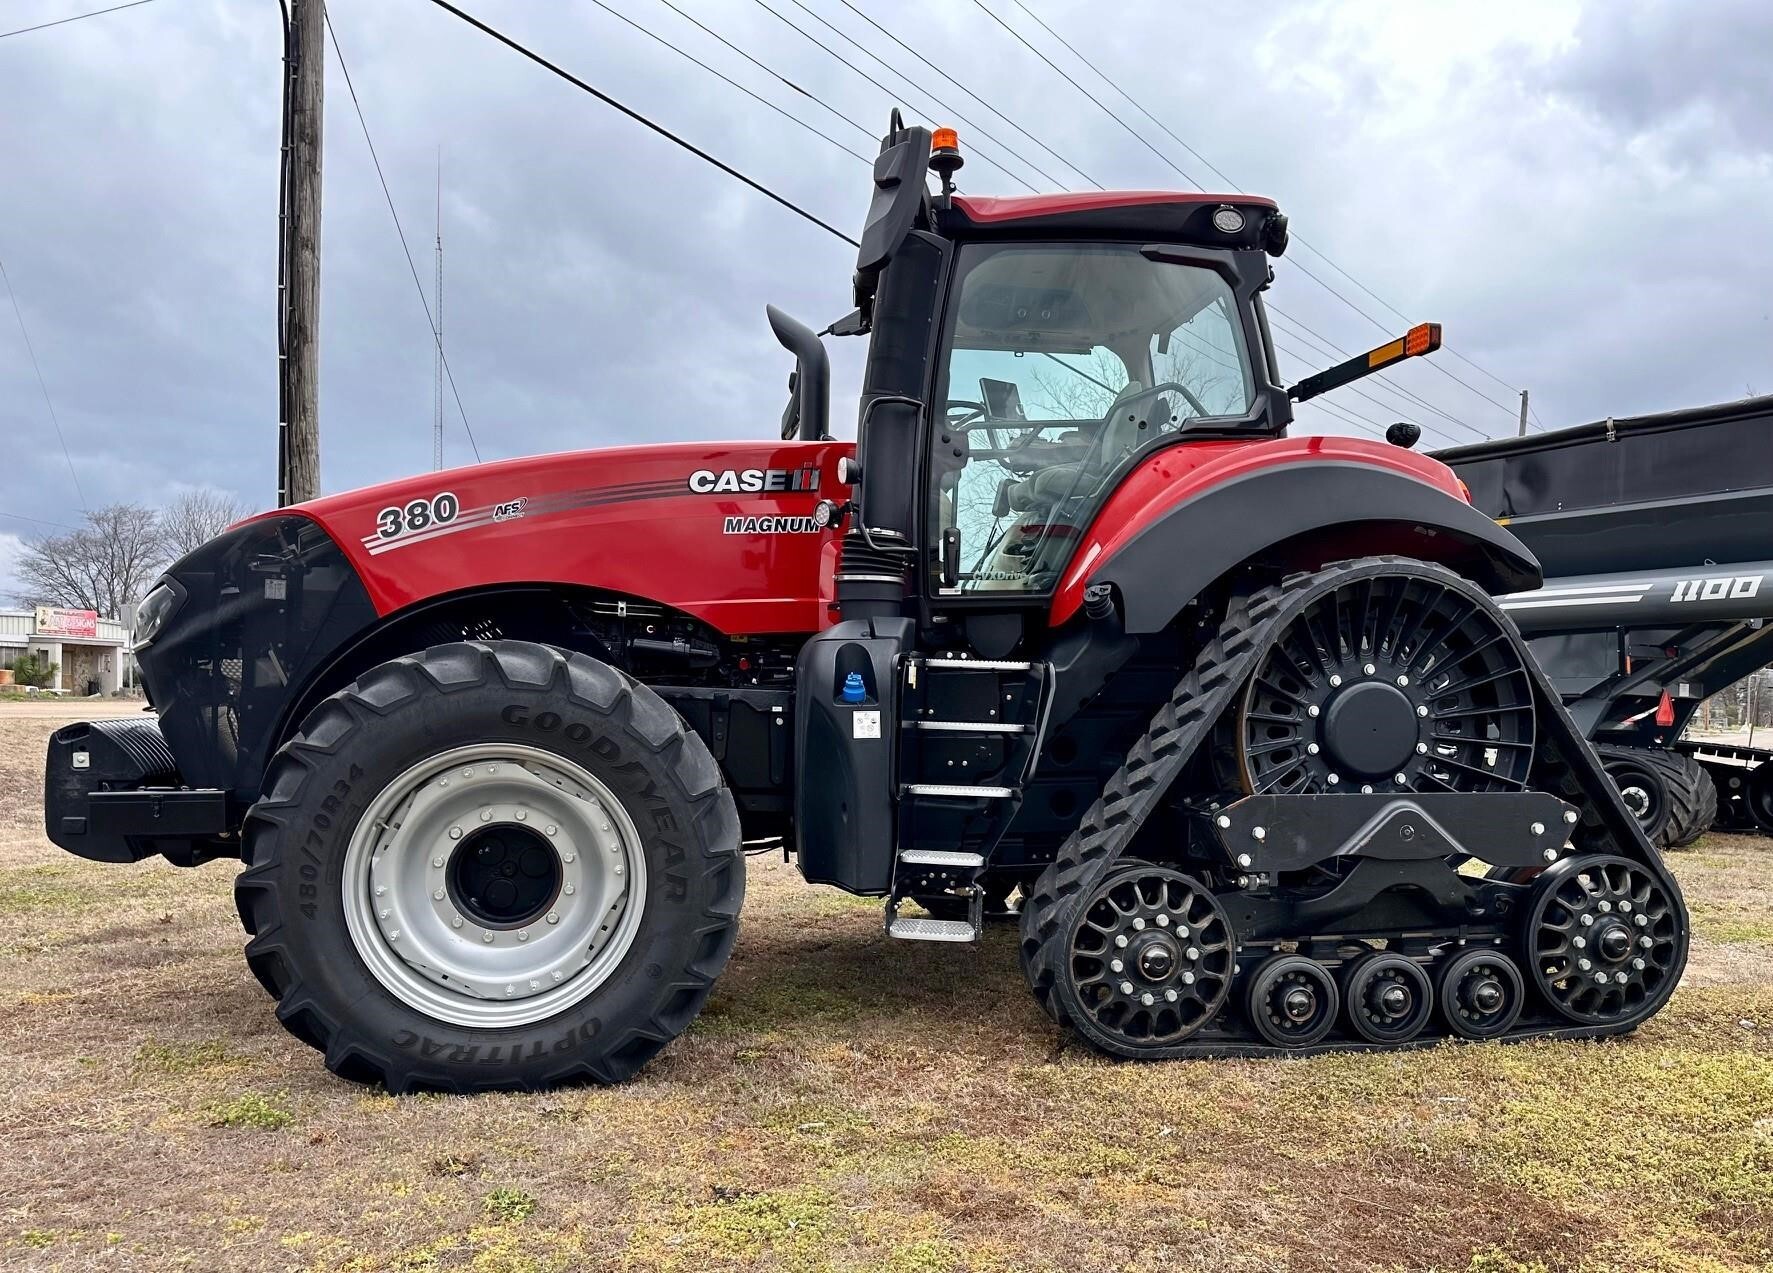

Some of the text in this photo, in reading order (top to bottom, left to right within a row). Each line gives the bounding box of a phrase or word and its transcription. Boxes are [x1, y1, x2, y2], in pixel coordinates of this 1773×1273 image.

[689, 469, 787, 493] CASE
[377, 492, 459, 540] 380
[494, 502, 520, 517] AFS
[723, 516, 821, 534] MAGNUM
[972, 570, 1028, 581] CVXDrive
[1669, 575, 1765, 602] 1100
[501, 704, 690, 904] GOODYEAR
[299, 762, 365, 921] 480/70R34
[391, 1016, 602, 1066] OPTITRAC
